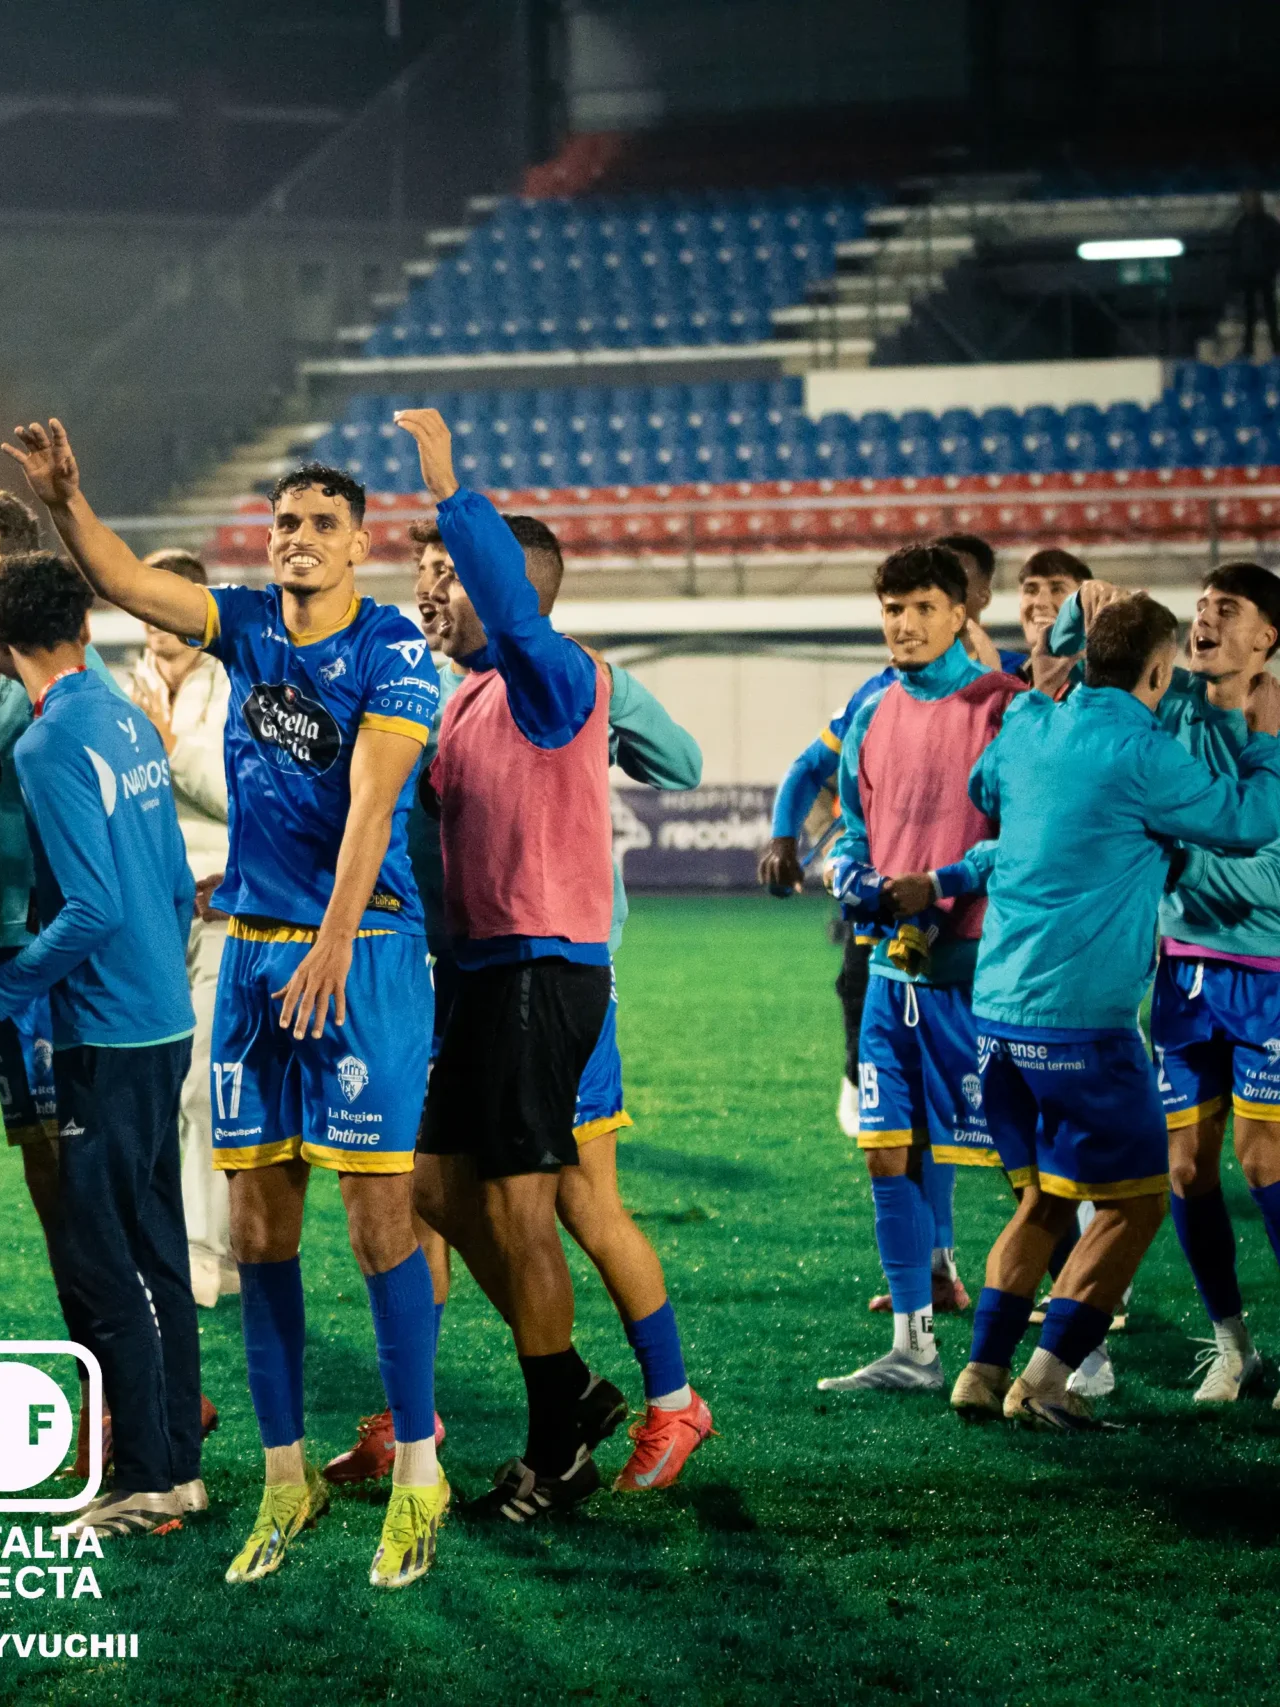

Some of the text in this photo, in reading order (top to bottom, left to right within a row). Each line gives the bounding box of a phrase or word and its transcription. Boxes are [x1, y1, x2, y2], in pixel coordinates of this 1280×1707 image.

[213, 1062, 243, 1120] 17
[328, 1107, 339, 1119] La
[327, 1125, 380, 1145] Ontime
